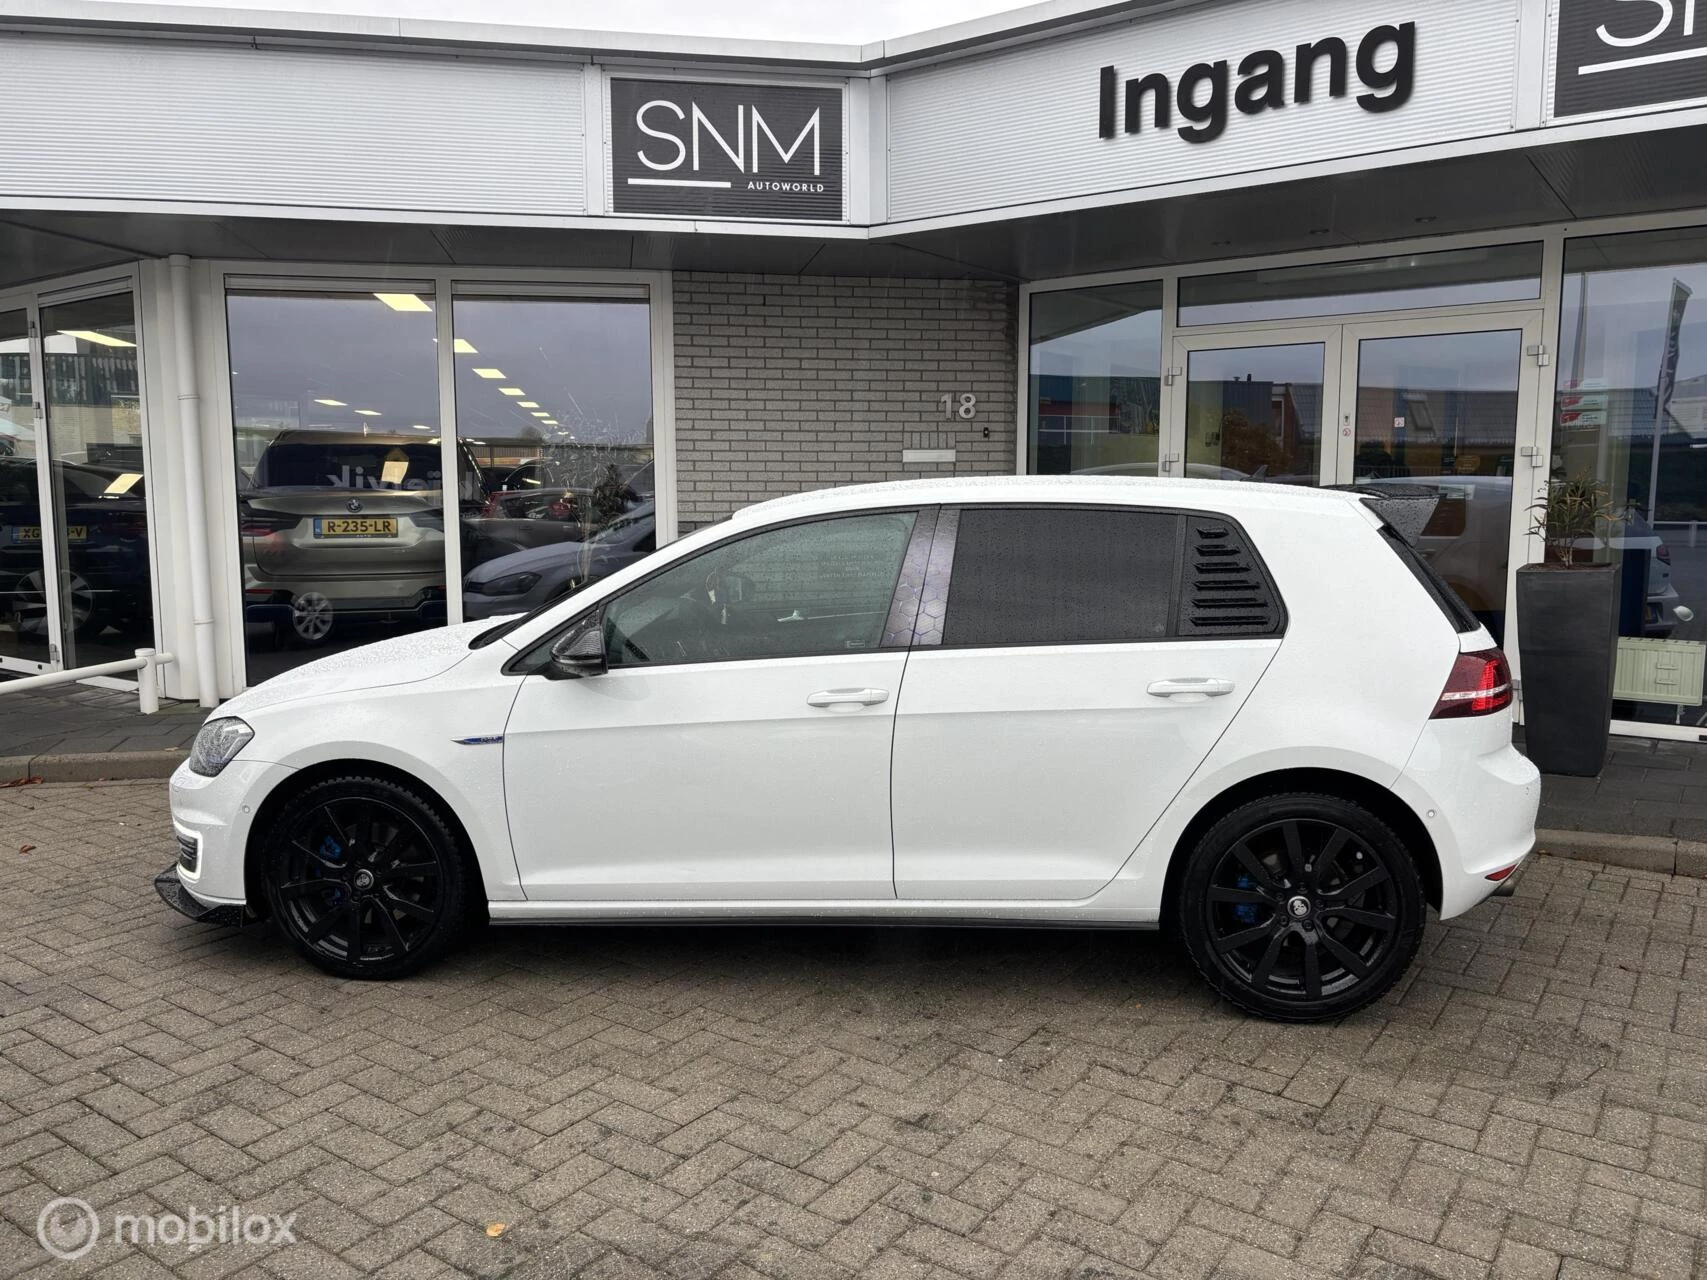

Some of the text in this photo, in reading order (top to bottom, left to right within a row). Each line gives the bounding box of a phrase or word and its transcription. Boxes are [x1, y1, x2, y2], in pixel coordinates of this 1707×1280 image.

[1099, 21, 1415, 143] Ingang
[636, 100, 821, 176] SNM
[748, 181, 824, 192] AUTOWORLD
[941, 393, 976, 419] 18
[327, 520, 392, 533] R-235-LR
